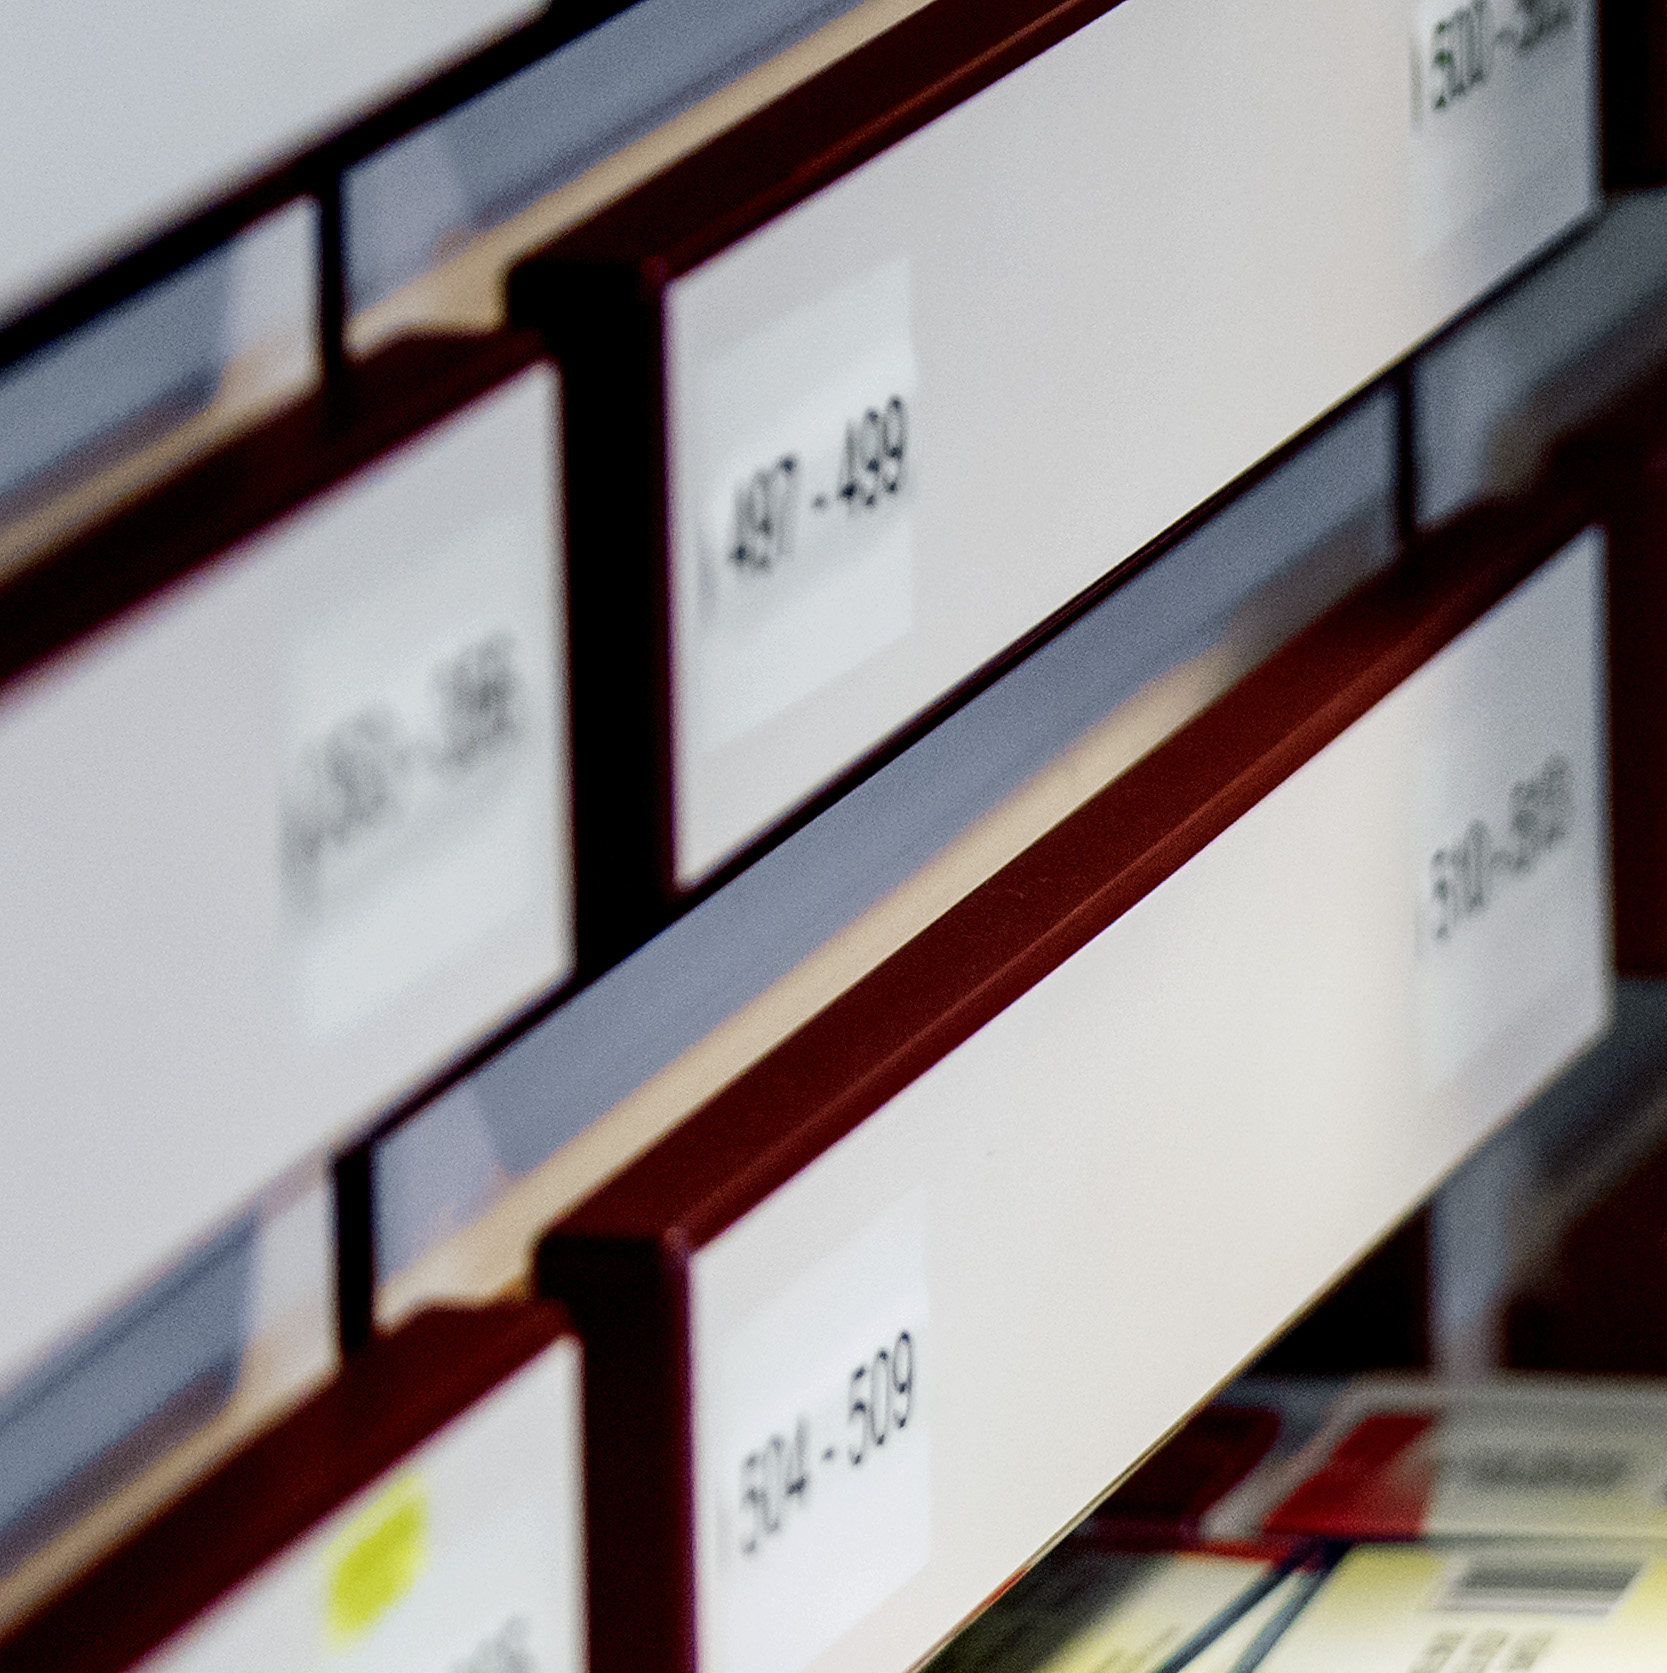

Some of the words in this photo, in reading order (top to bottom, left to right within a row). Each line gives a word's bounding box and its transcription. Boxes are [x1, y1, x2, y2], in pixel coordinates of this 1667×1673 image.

[727, 452, 799, 574] 497
[837, 393, 910, 511] 499
[740, 1413, 808, 1557] 504
[848, 1328, 915, 1467] 509
